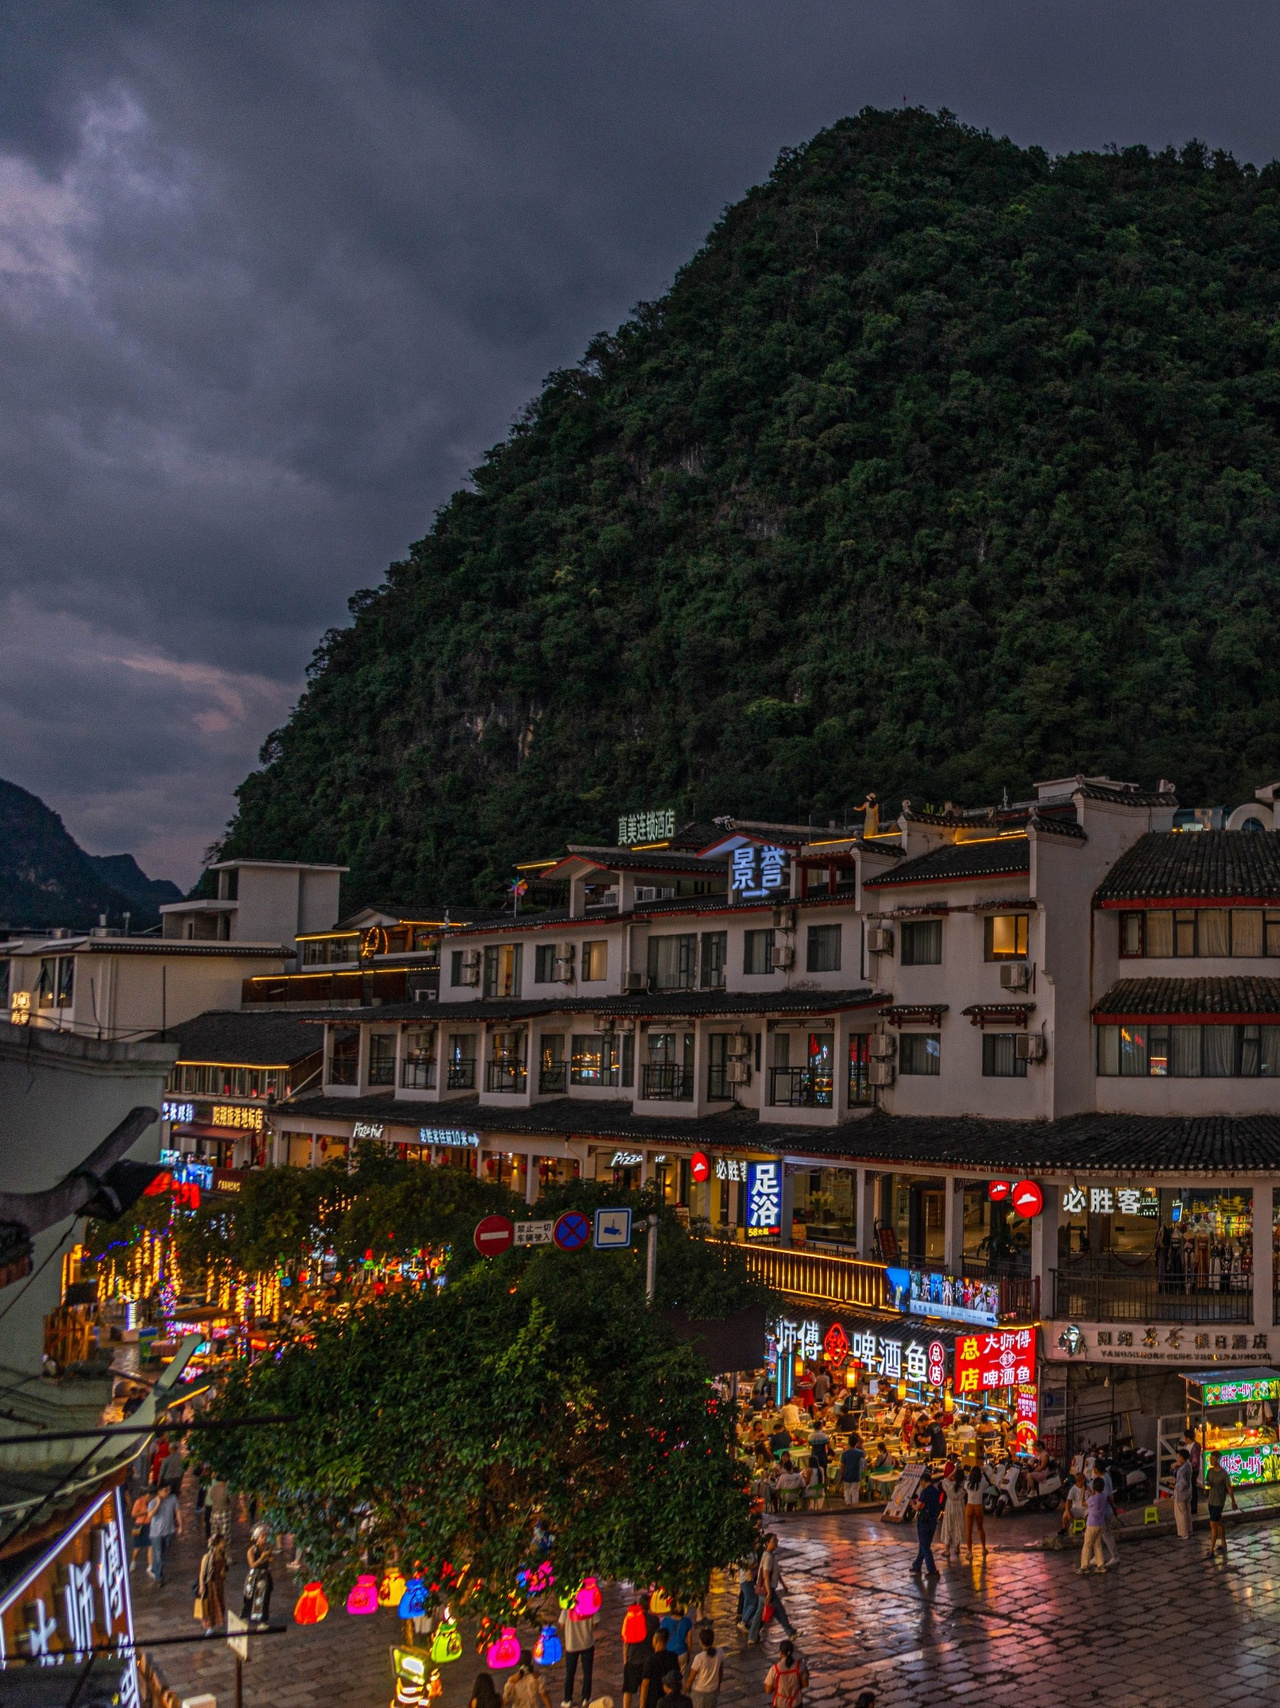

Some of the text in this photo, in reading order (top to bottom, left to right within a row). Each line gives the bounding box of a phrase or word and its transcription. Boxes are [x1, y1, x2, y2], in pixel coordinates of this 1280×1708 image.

[618, 808, 676, 845] 真美连锁酒店
[732, 845, 785, 890] 景誉
[750, 1164, 779, 1227] 足浴
[1063, 1187, 1141, 1214] 必胜客
[516, 1223, 551, 1233] 禁止一切
[853, 1330, 928, 1383] 啤酒鱼
[982, 1330, 1032, 1355] 大师傅
[931, 1346, 942, 1382] 总店
[959, 1337, 981, 1392] 总店
[982, 1366, 1031, 1389] 啤酒鱼
